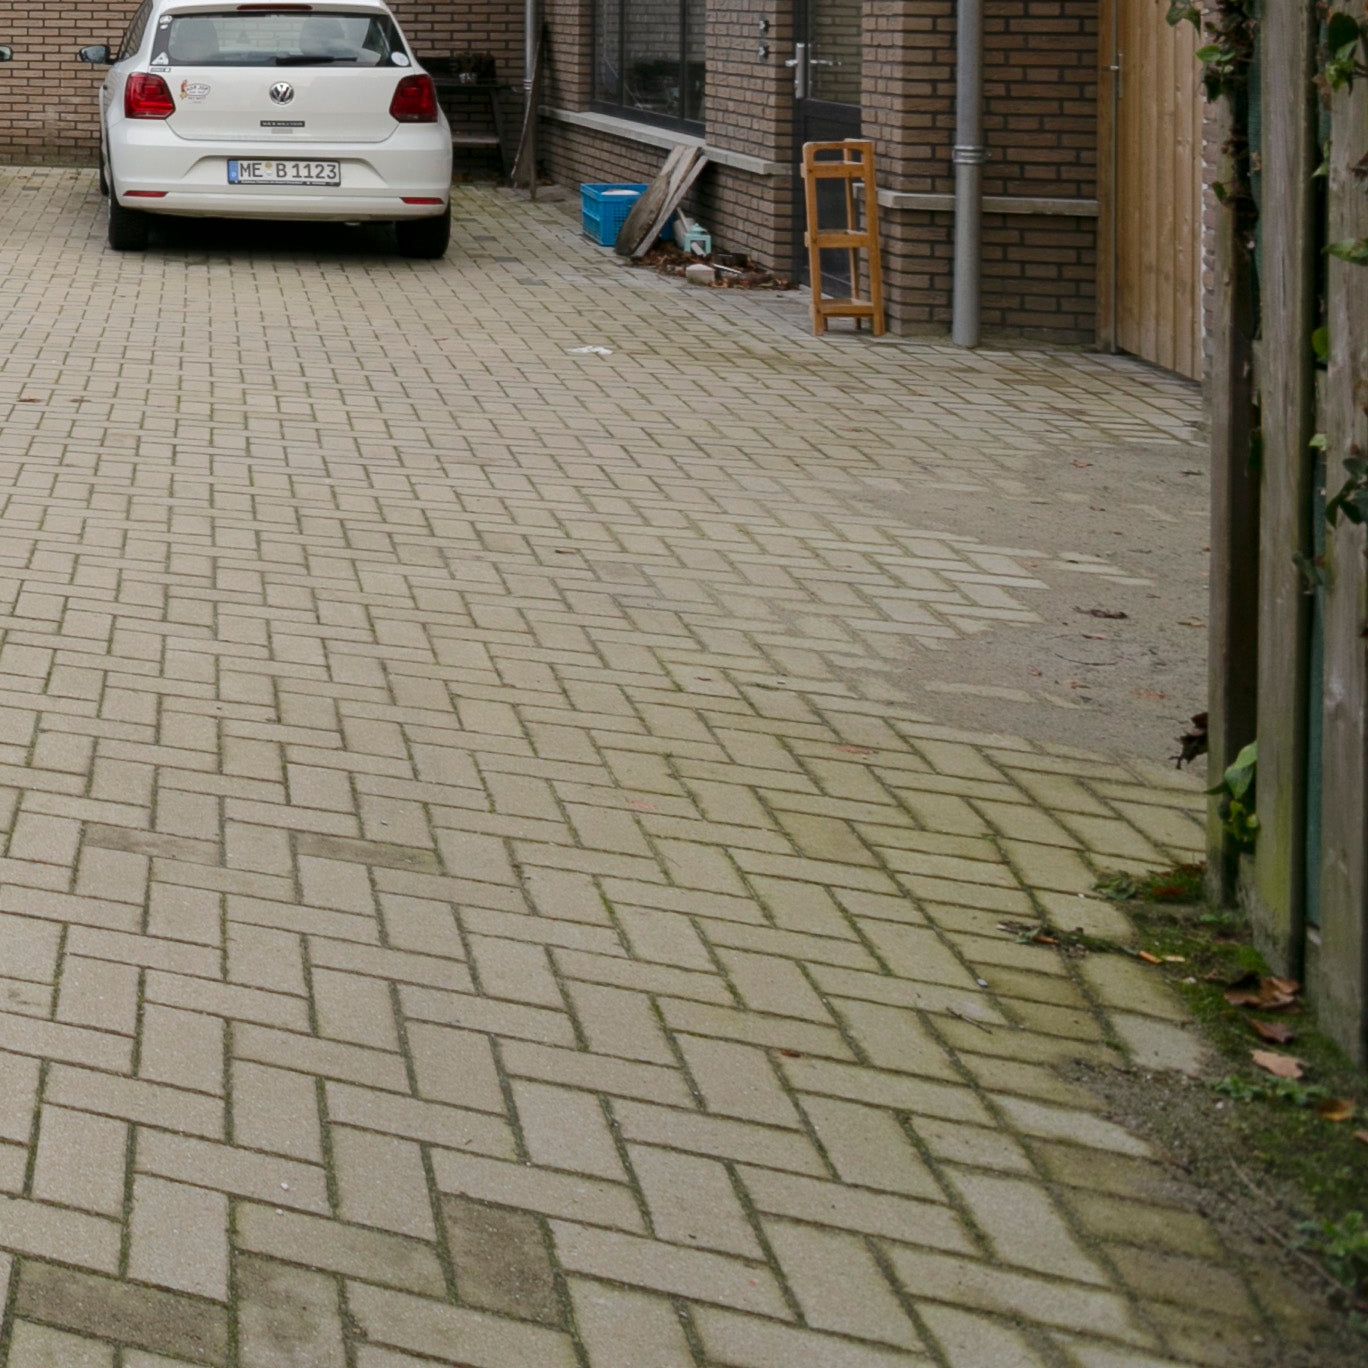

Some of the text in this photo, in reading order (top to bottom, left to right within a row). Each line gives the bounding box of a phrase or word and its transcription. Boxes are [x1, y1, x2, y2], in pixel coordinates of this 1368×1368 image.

[240, 162, 337, 180] ME B 1123
